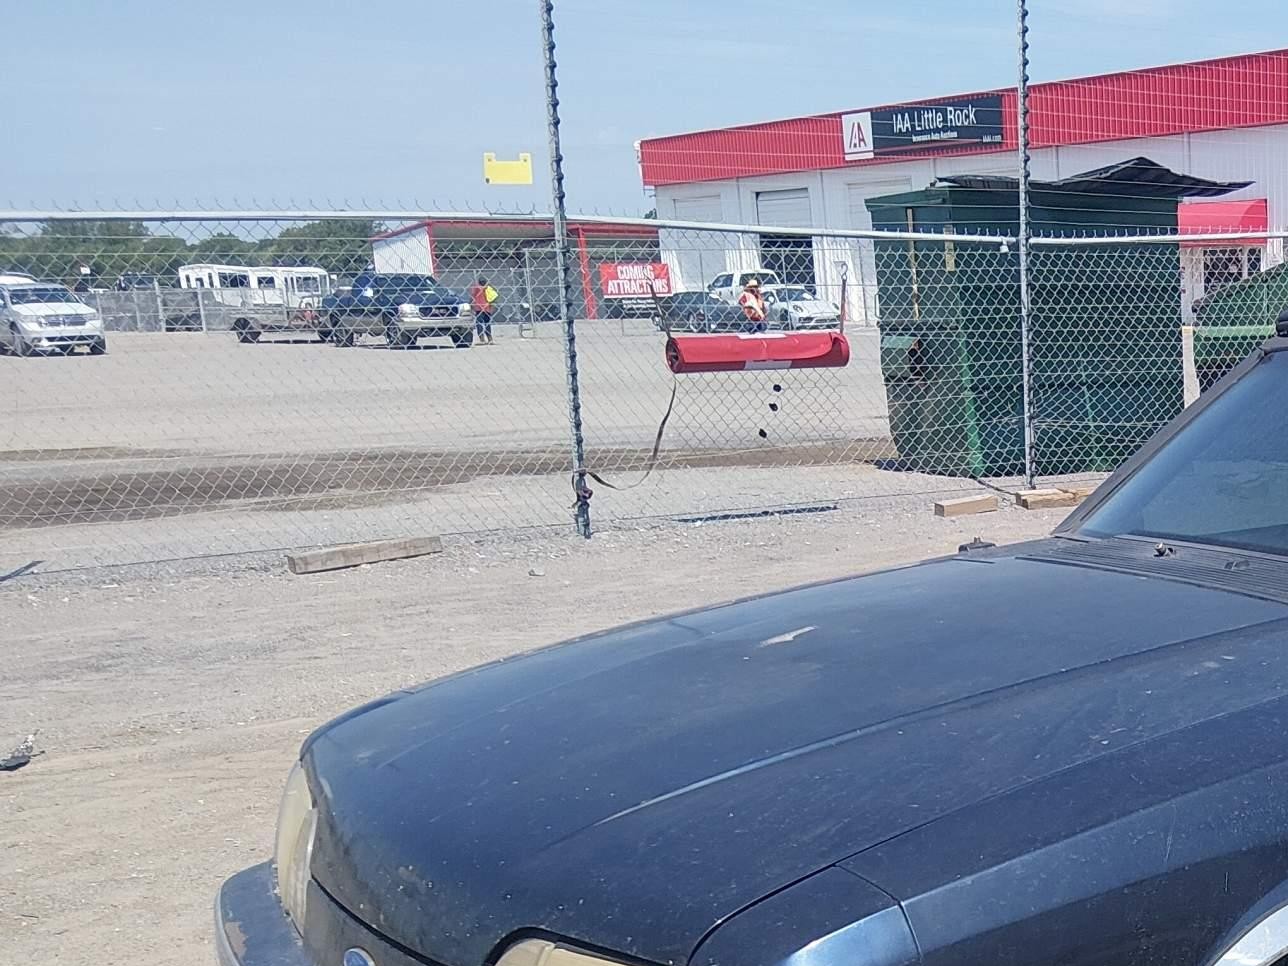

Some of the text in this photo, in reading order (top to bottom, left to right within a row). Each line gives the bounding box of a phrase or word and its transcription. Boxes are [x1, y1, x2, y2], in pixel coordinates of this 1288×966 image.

[892, 103, 977, 134] IAA Little Rock
[616, 264, 655, 280] COMING
